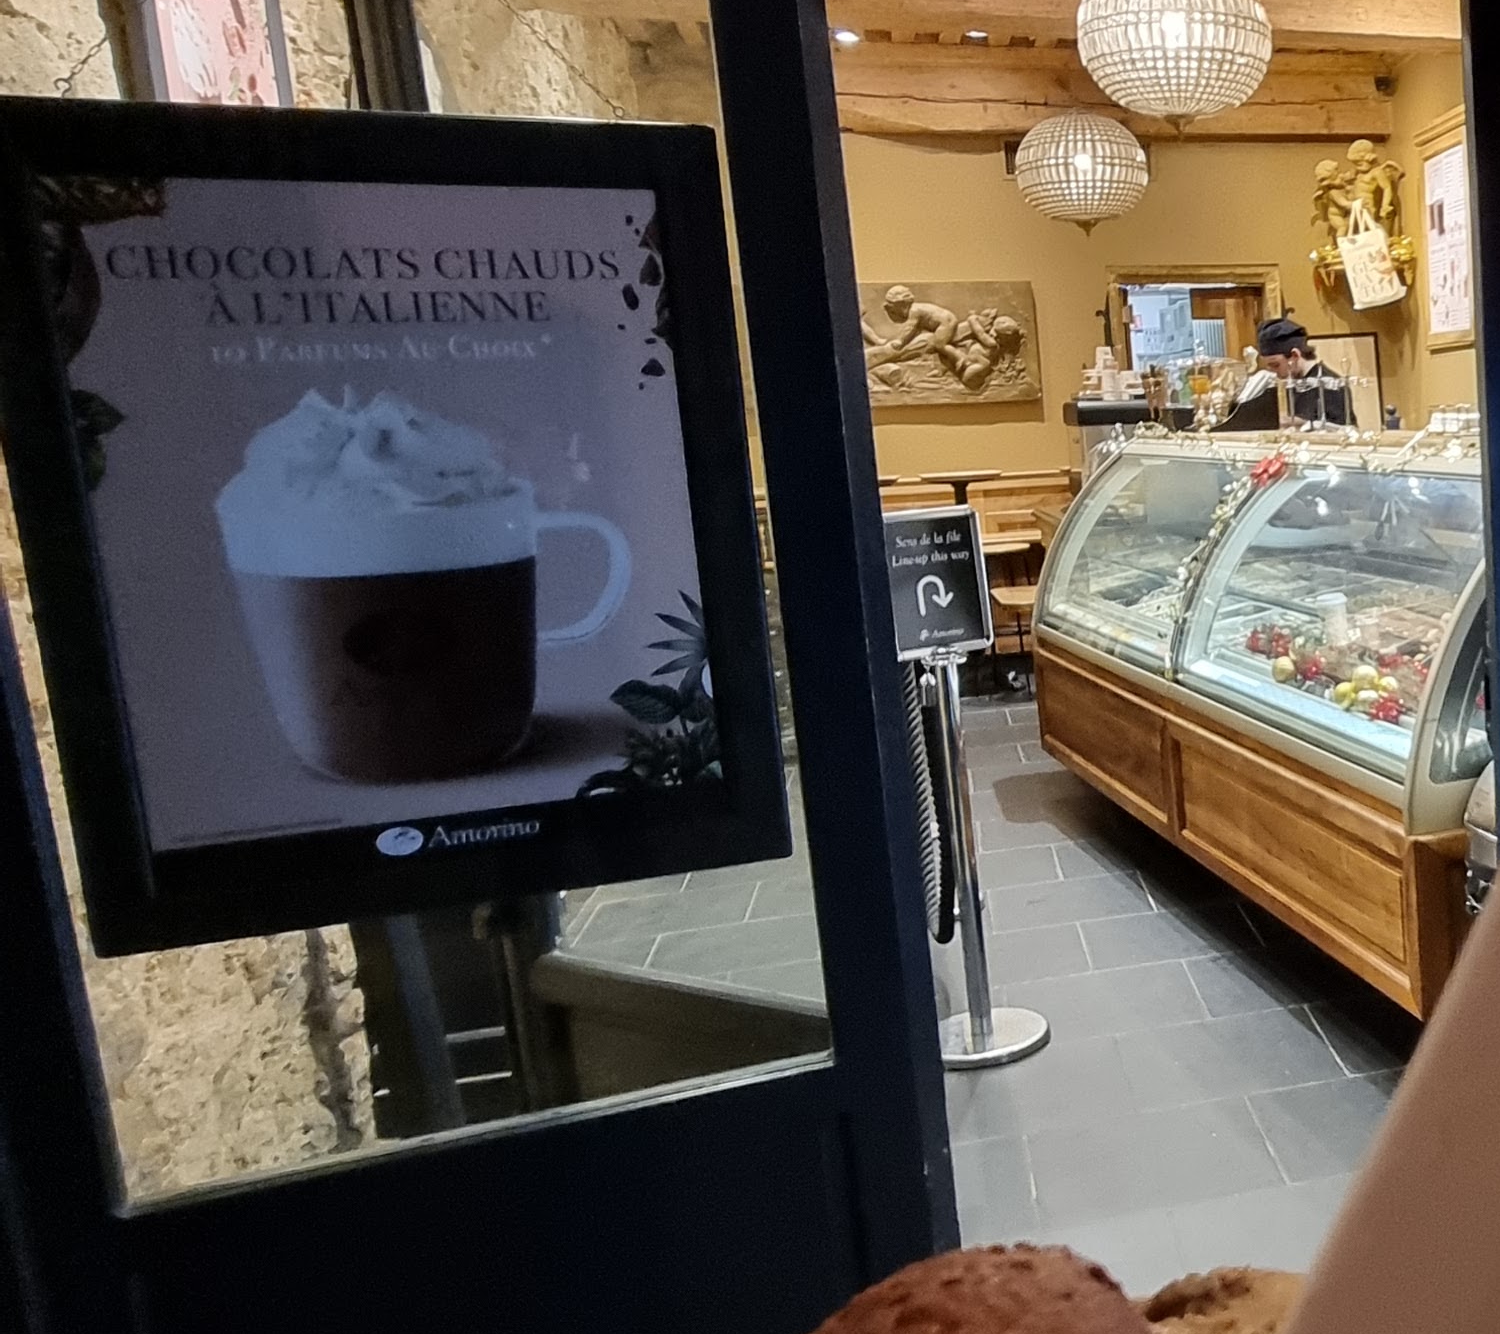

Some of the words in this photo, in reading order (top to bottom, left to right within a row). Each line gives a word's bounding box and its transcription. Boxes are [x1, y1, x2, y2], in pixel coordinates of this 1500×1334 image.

[105, 243, 421, 280] CHOCOLATS
[433, 248, 621, 281] CHAUDS
[208, 283, 240, 327] À
[427, 819, 541, 848] Amorino
